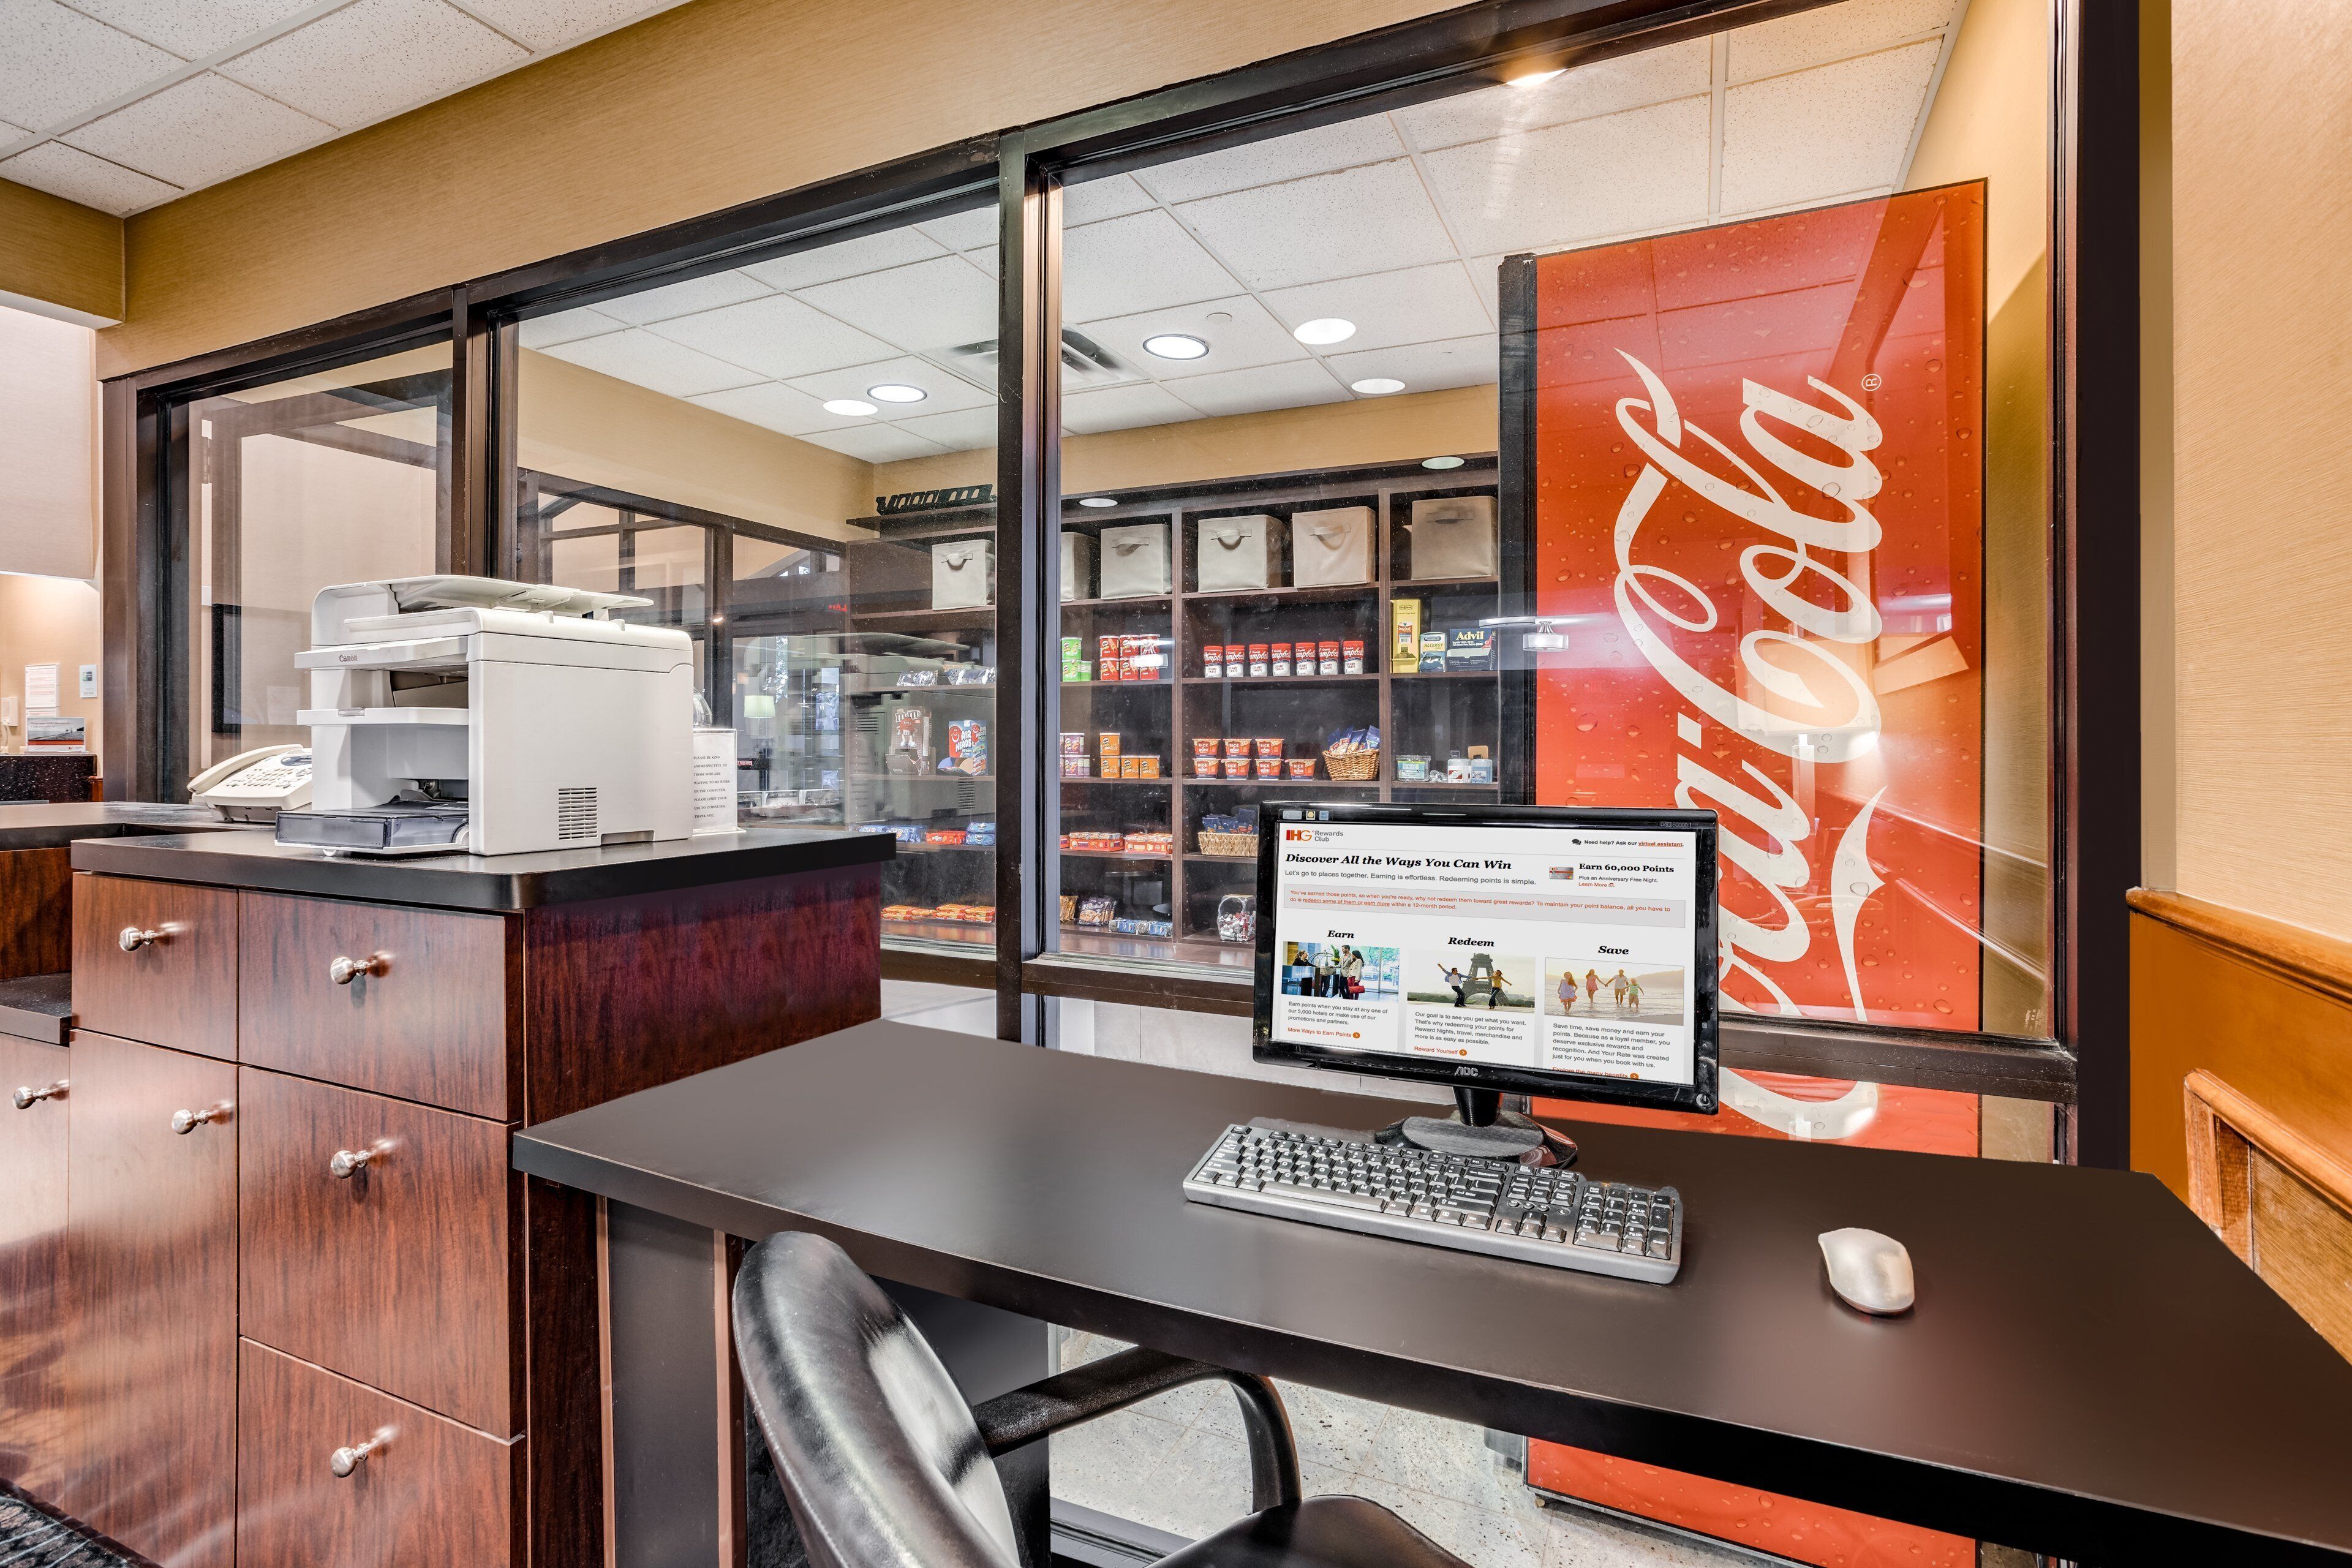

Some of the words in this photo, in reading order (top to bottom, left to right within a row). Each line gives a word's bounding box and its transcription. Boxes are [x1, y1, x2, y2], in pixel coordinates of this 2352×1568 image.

[1456, 631, 1485, 640] Advil
[961, 730, 972, 741] AIR
[956, 739, 973, 752] HEADS
[1613, 347, 1887, 1139] Cca-Cola
[1286, 830, 1312, 841] IHG
[1285, 854, 1339, 863] Discover
[1362, 856, 1382, 865] the
[1385, 858, 1422, 868] Ways
[1453, 859, 1480, 868] Can
[1483, 861, 1511, 869] Win
[1327, 929, 1355, 940] Earn
[1448, 937, 1495, 948] Redeem
[1598, 944, 1629, 956] Save
[1455, 1066, 1479, 1077] AOC
